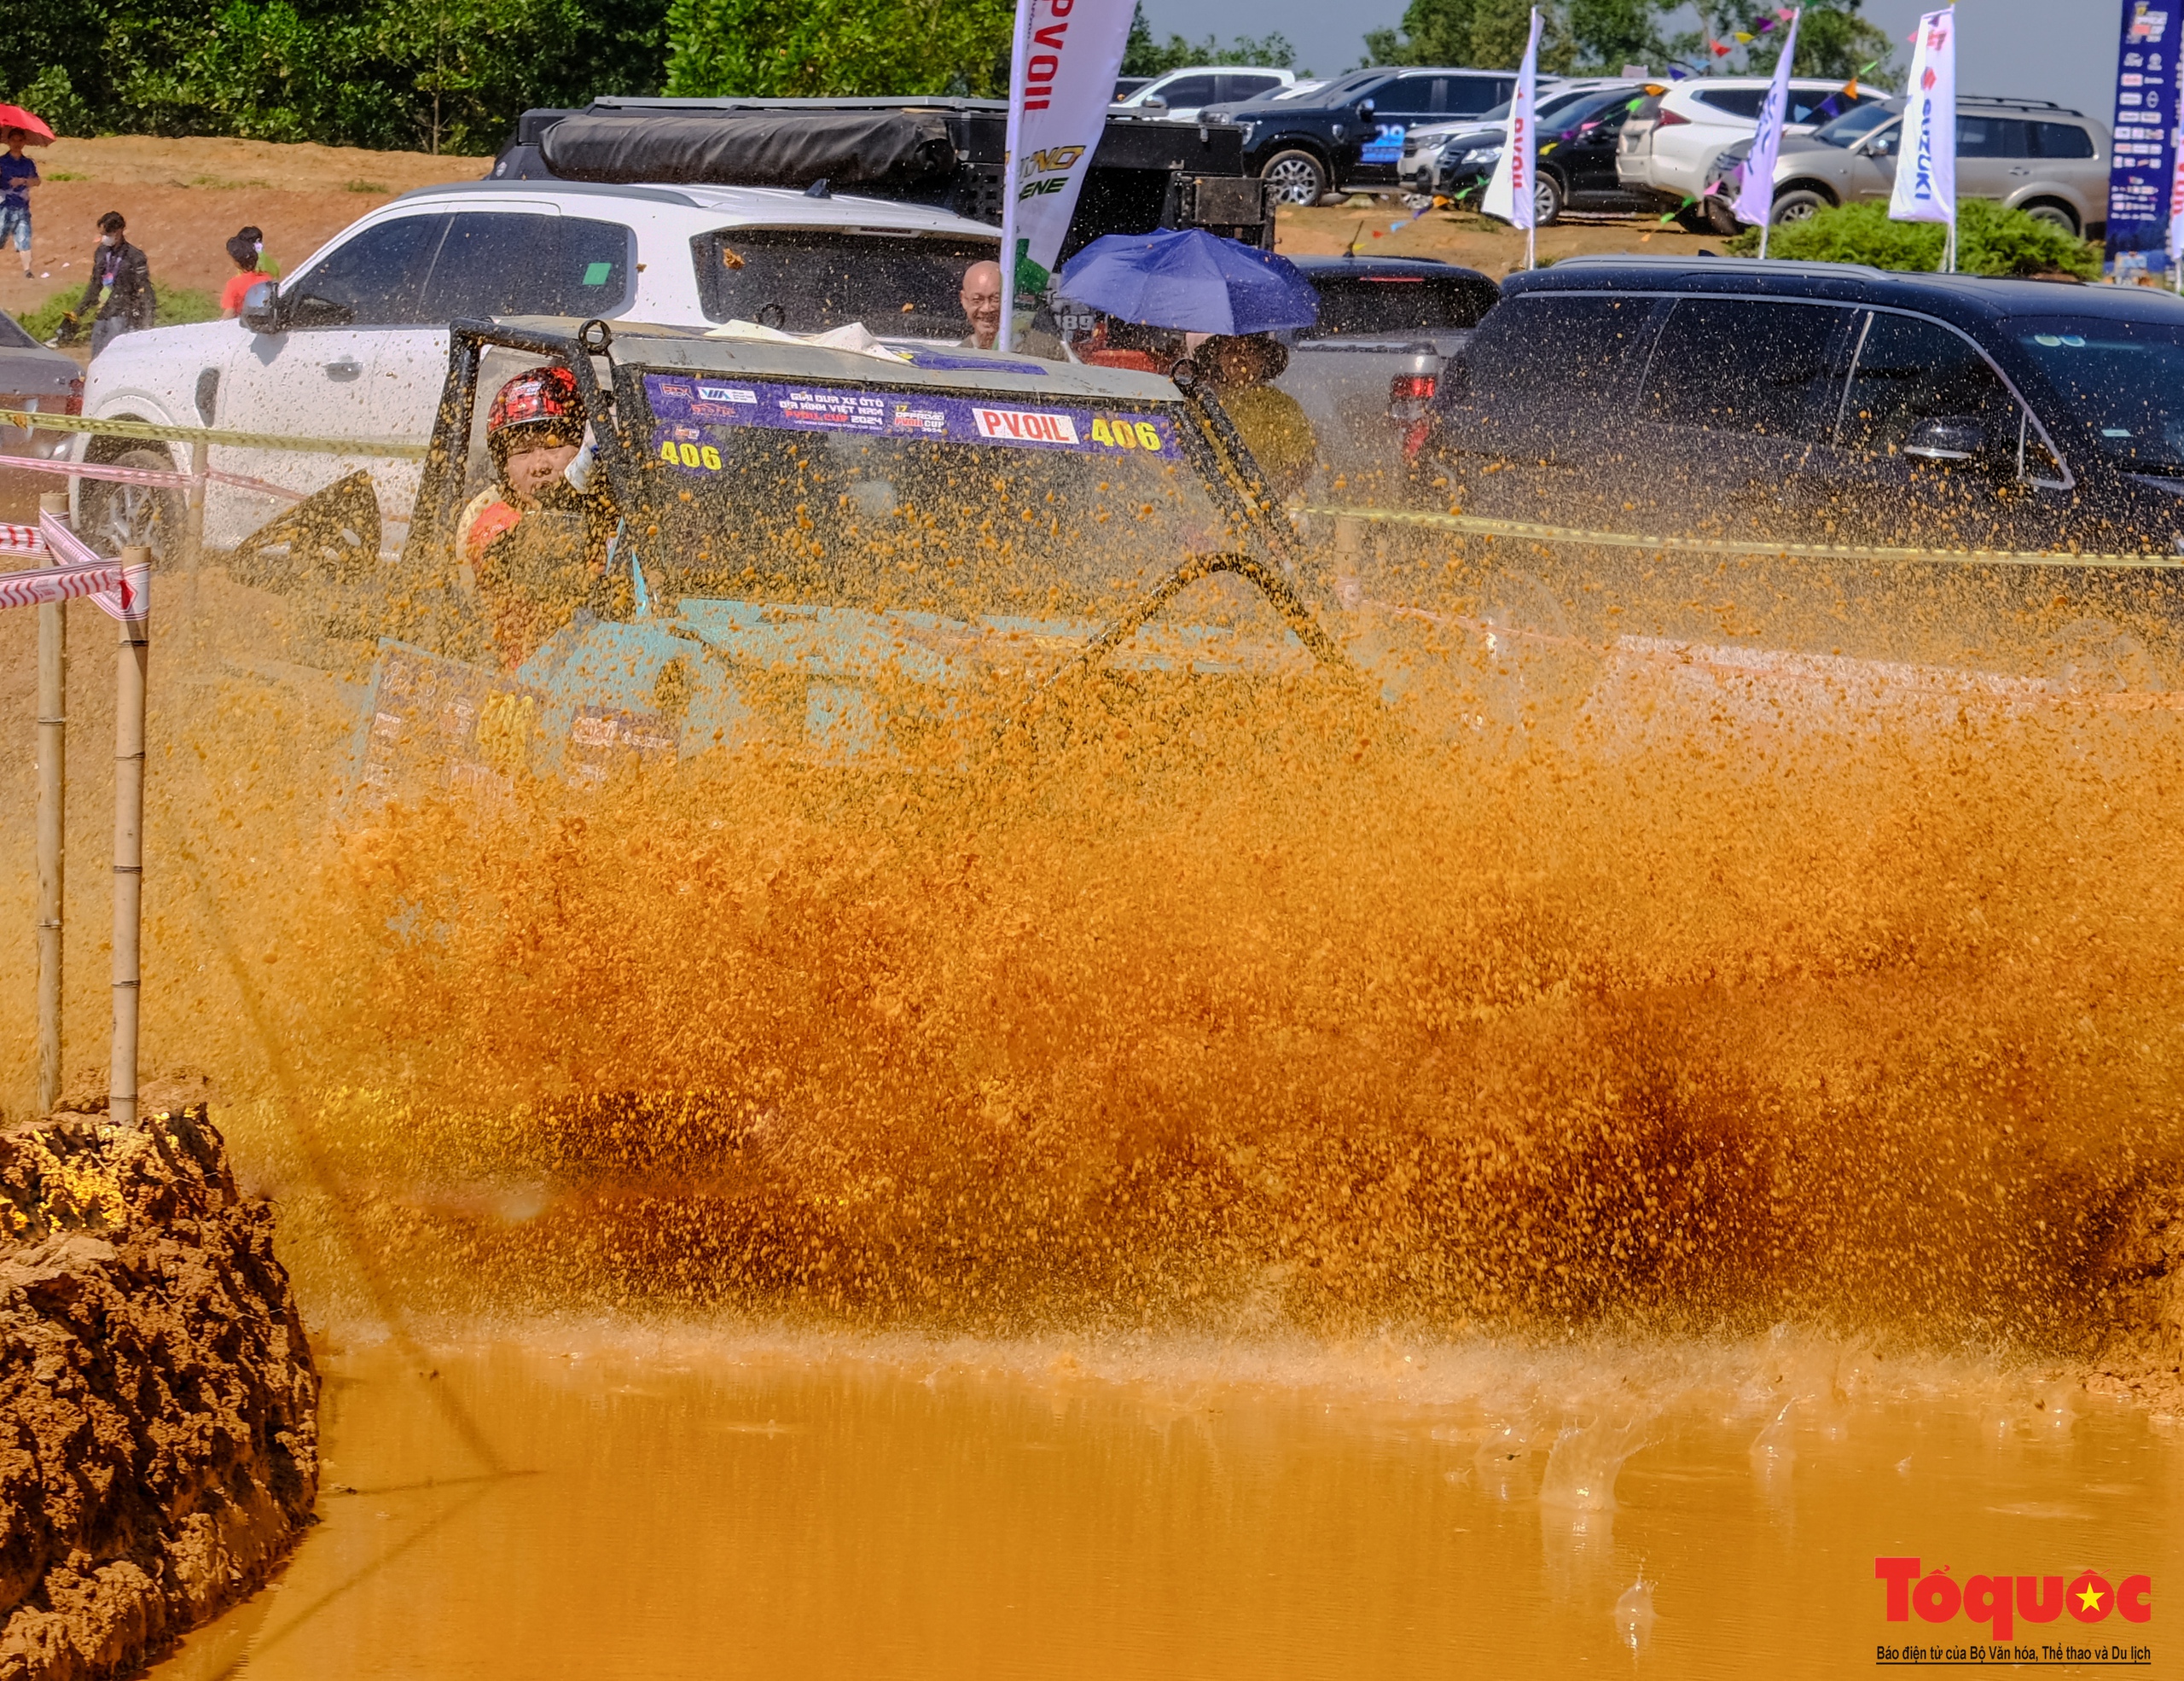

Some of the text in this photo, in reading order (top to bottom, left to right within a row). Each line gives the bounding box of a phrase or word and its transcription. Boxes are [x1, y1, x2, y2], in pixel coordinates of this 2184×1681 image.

[840, 396, 857, 406] XE
[858, 407, 884, 416] NAM
[823, 412, 849, 422] CUP
[851, 415, 884, 425] 2024
[983, 411, 1070, 441] PVOIL
[1091, 417, 1161, 451] 406
[661, 441, 723, 470] 406
